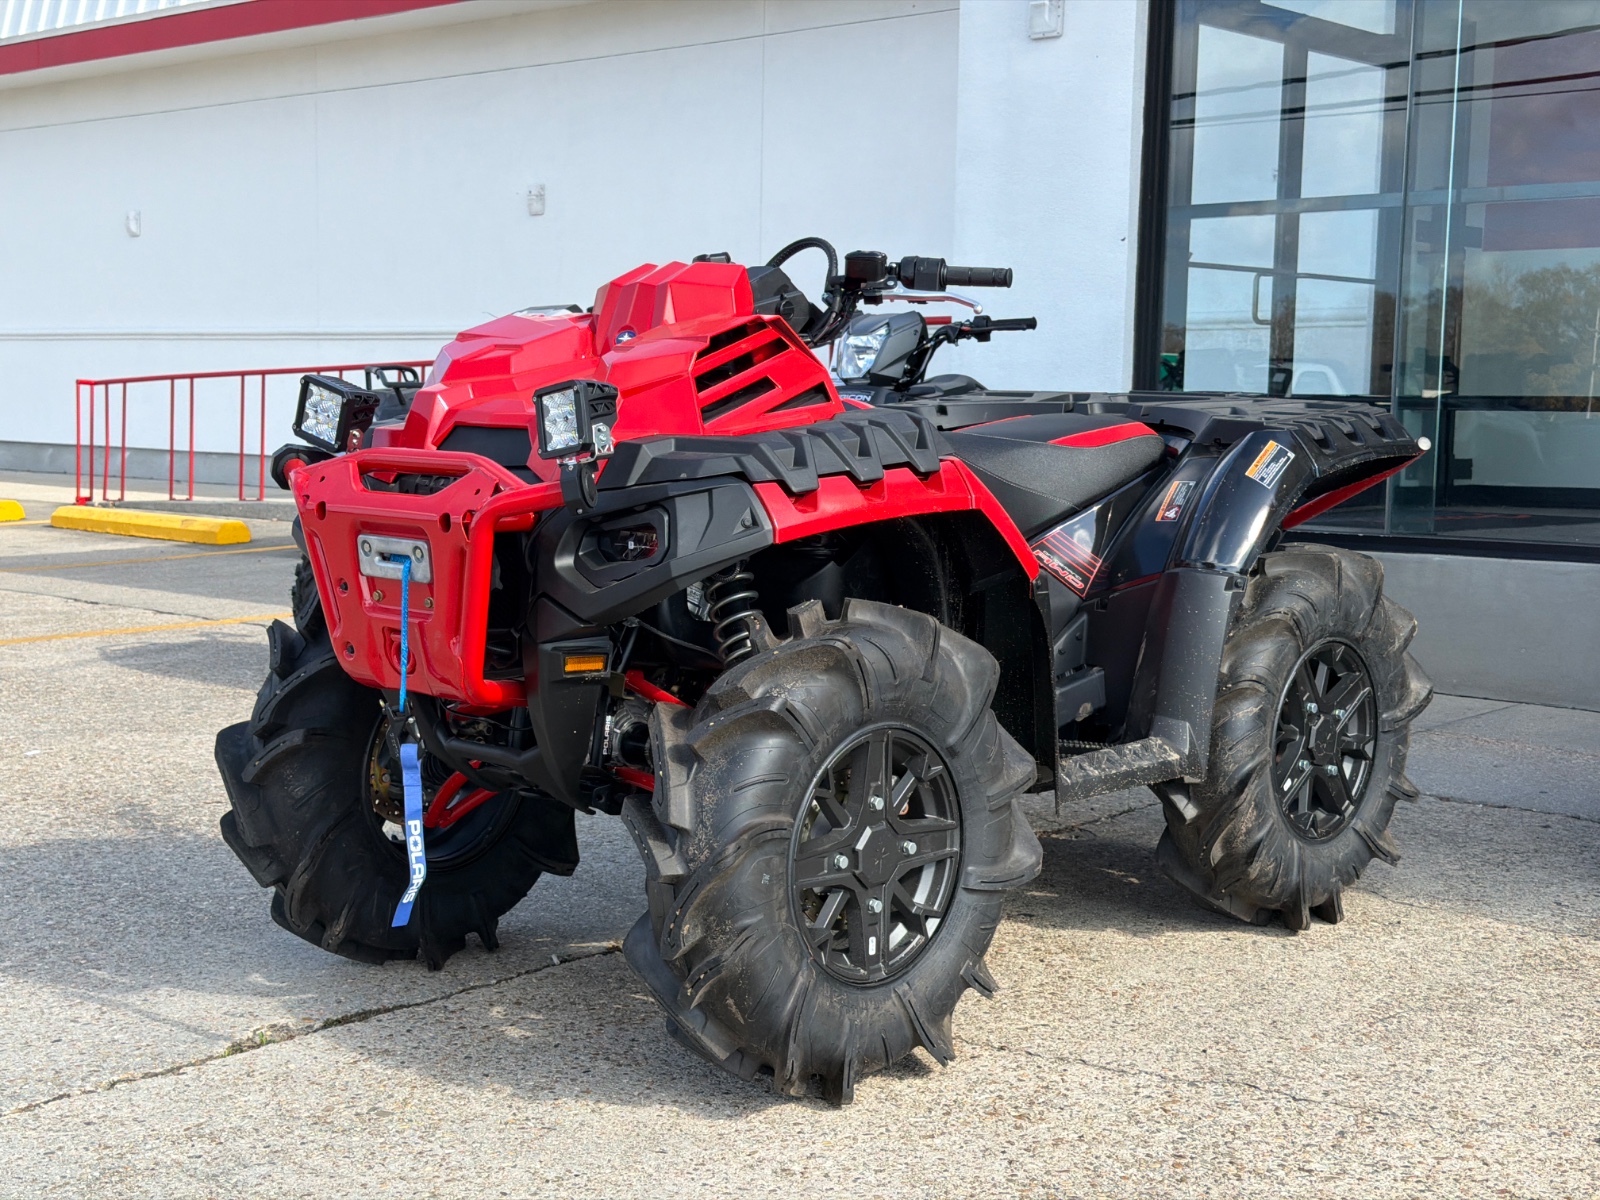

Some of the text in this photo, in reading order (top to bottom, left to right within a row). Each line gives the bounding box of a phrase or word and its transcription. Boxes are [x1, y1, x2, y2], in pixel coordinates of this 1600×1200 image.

[1032, 549, 1085, 589] AWD
[603, 715, 612, 755] POLARIS
[402, 819, 425, 904] POLARIS
